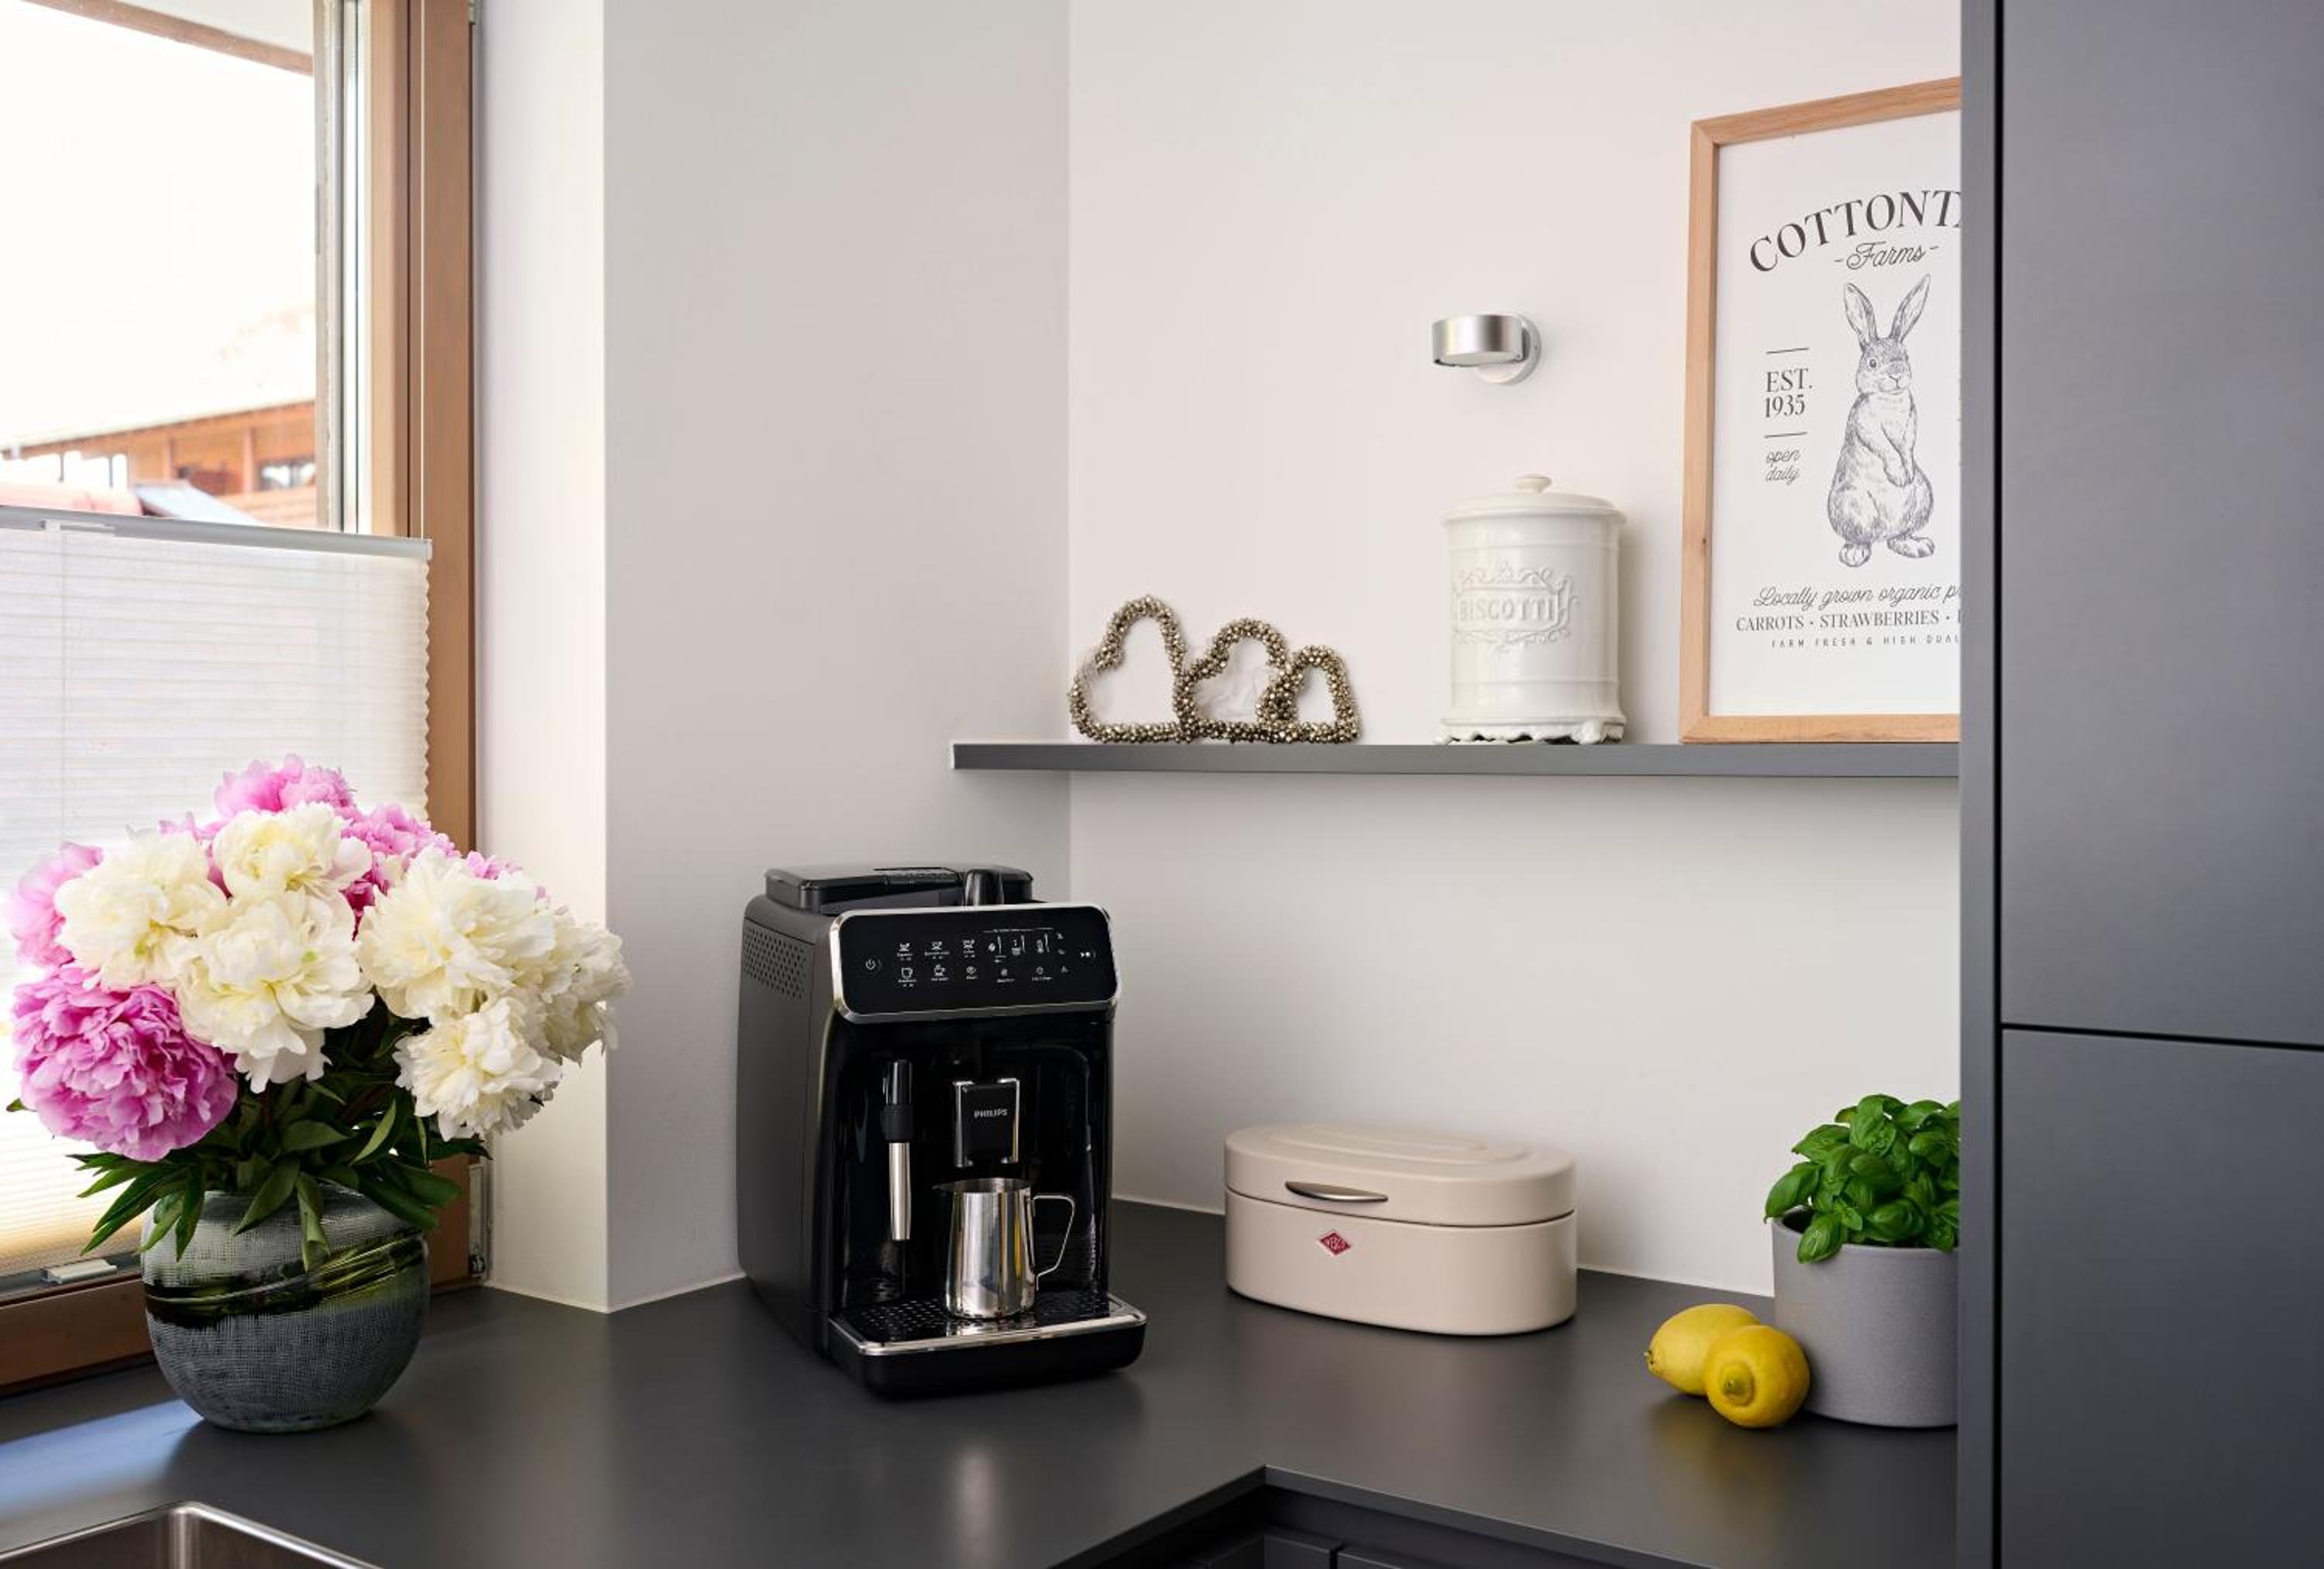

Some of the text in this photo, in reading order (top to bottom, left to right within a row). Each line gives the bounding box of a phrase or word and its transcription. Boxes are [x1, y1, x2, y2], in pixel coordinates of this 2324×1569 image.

[1750, 190, 1959, 272] COTTONT
[1765, 368, 1813, 392] EST.
[1765, 394, 1805, 418] 1935
[1765, 449, 1801, 467] open
[1765, 465, 1800, 486] daily
[1459, 597, 1555, 620] BISCOTTI
[1753, 586, 1817, 611] Locally
[1818, 589, 1873, 610] grown
[1878, 586, 1941, 607] organic
[1736, 616, 1804, 631] CARROTS
[1820, 609, 1939, 629] STRAWBERRIES
[974, 1108, 1008, 1118] PHILIPS
